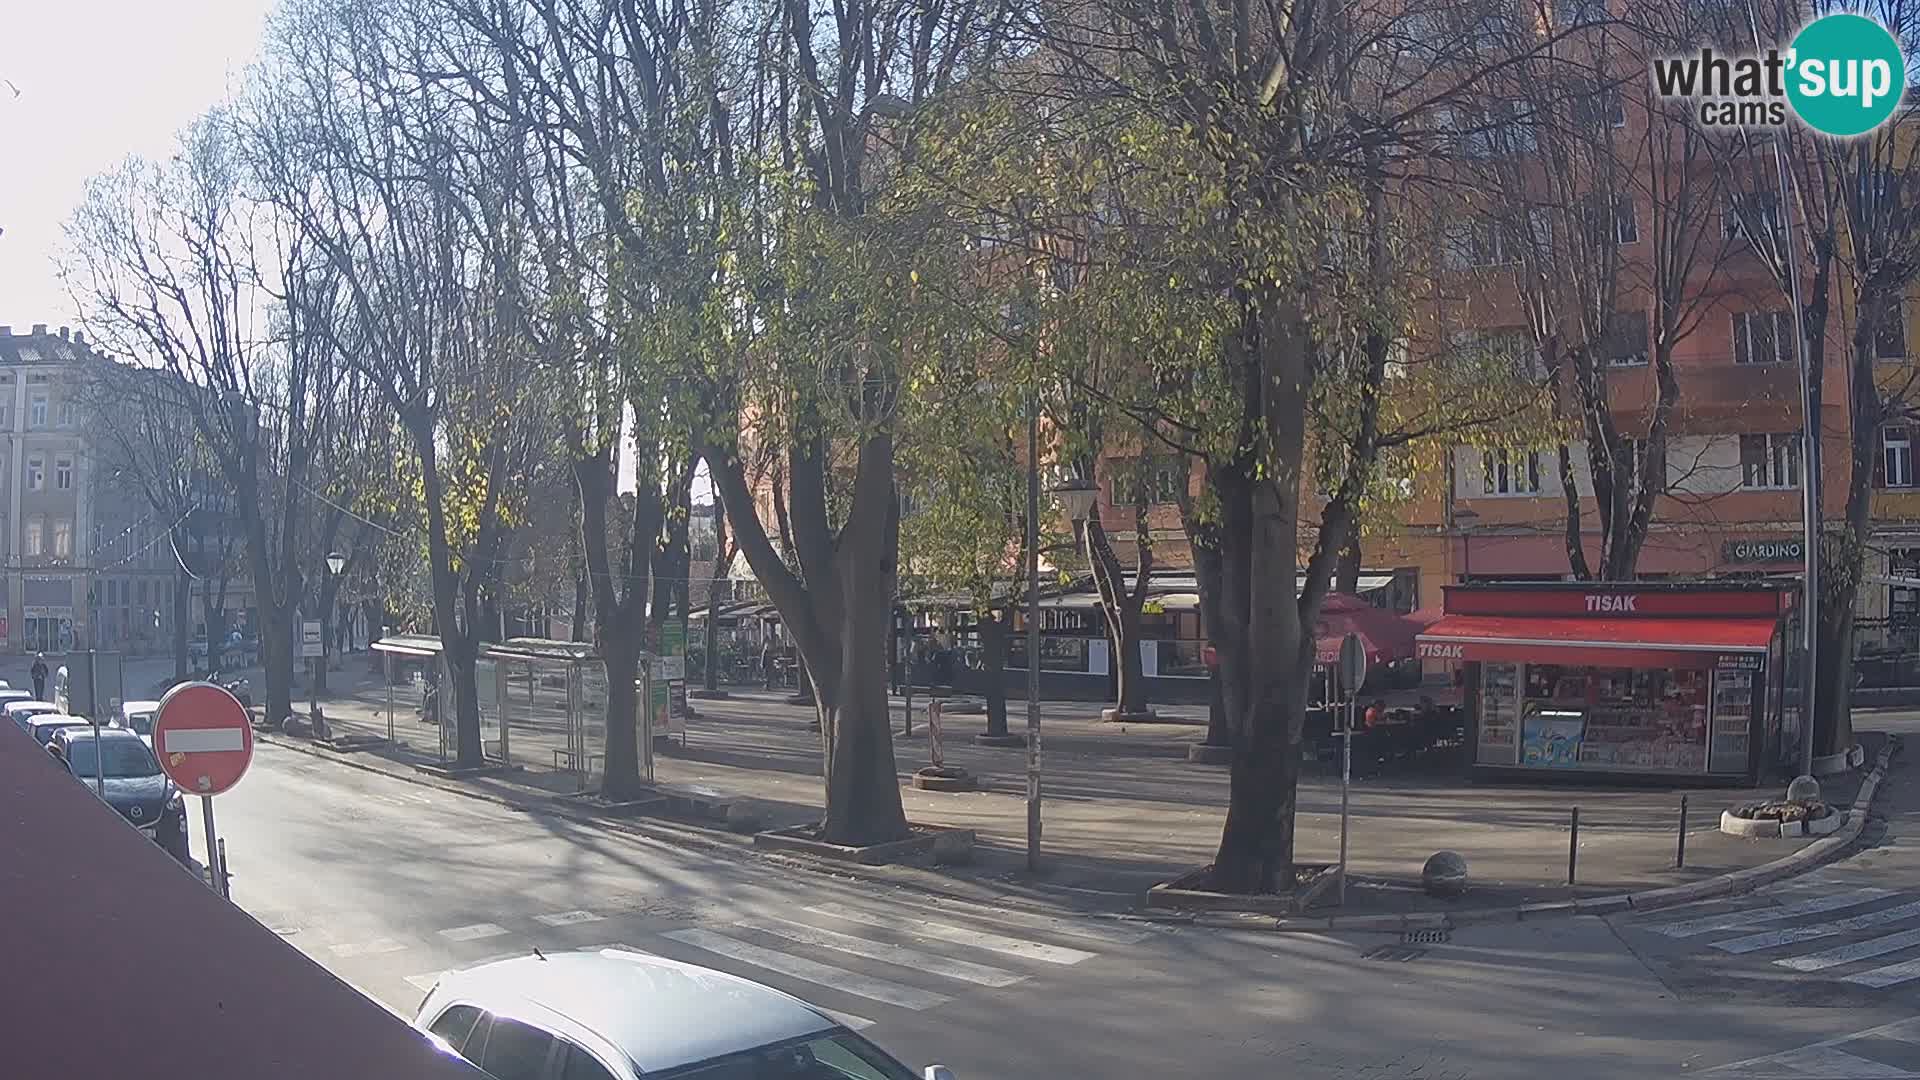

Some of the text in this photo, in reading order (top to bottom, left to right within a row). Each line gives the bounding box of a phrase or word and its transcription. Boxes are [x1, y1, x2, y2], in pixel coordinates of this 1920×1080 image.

[1735, 543, 1801, 558] GIARDINO
[1585, 595, 1637, 612] TISAK
[1419, 643, 1464, 658] TISAK
